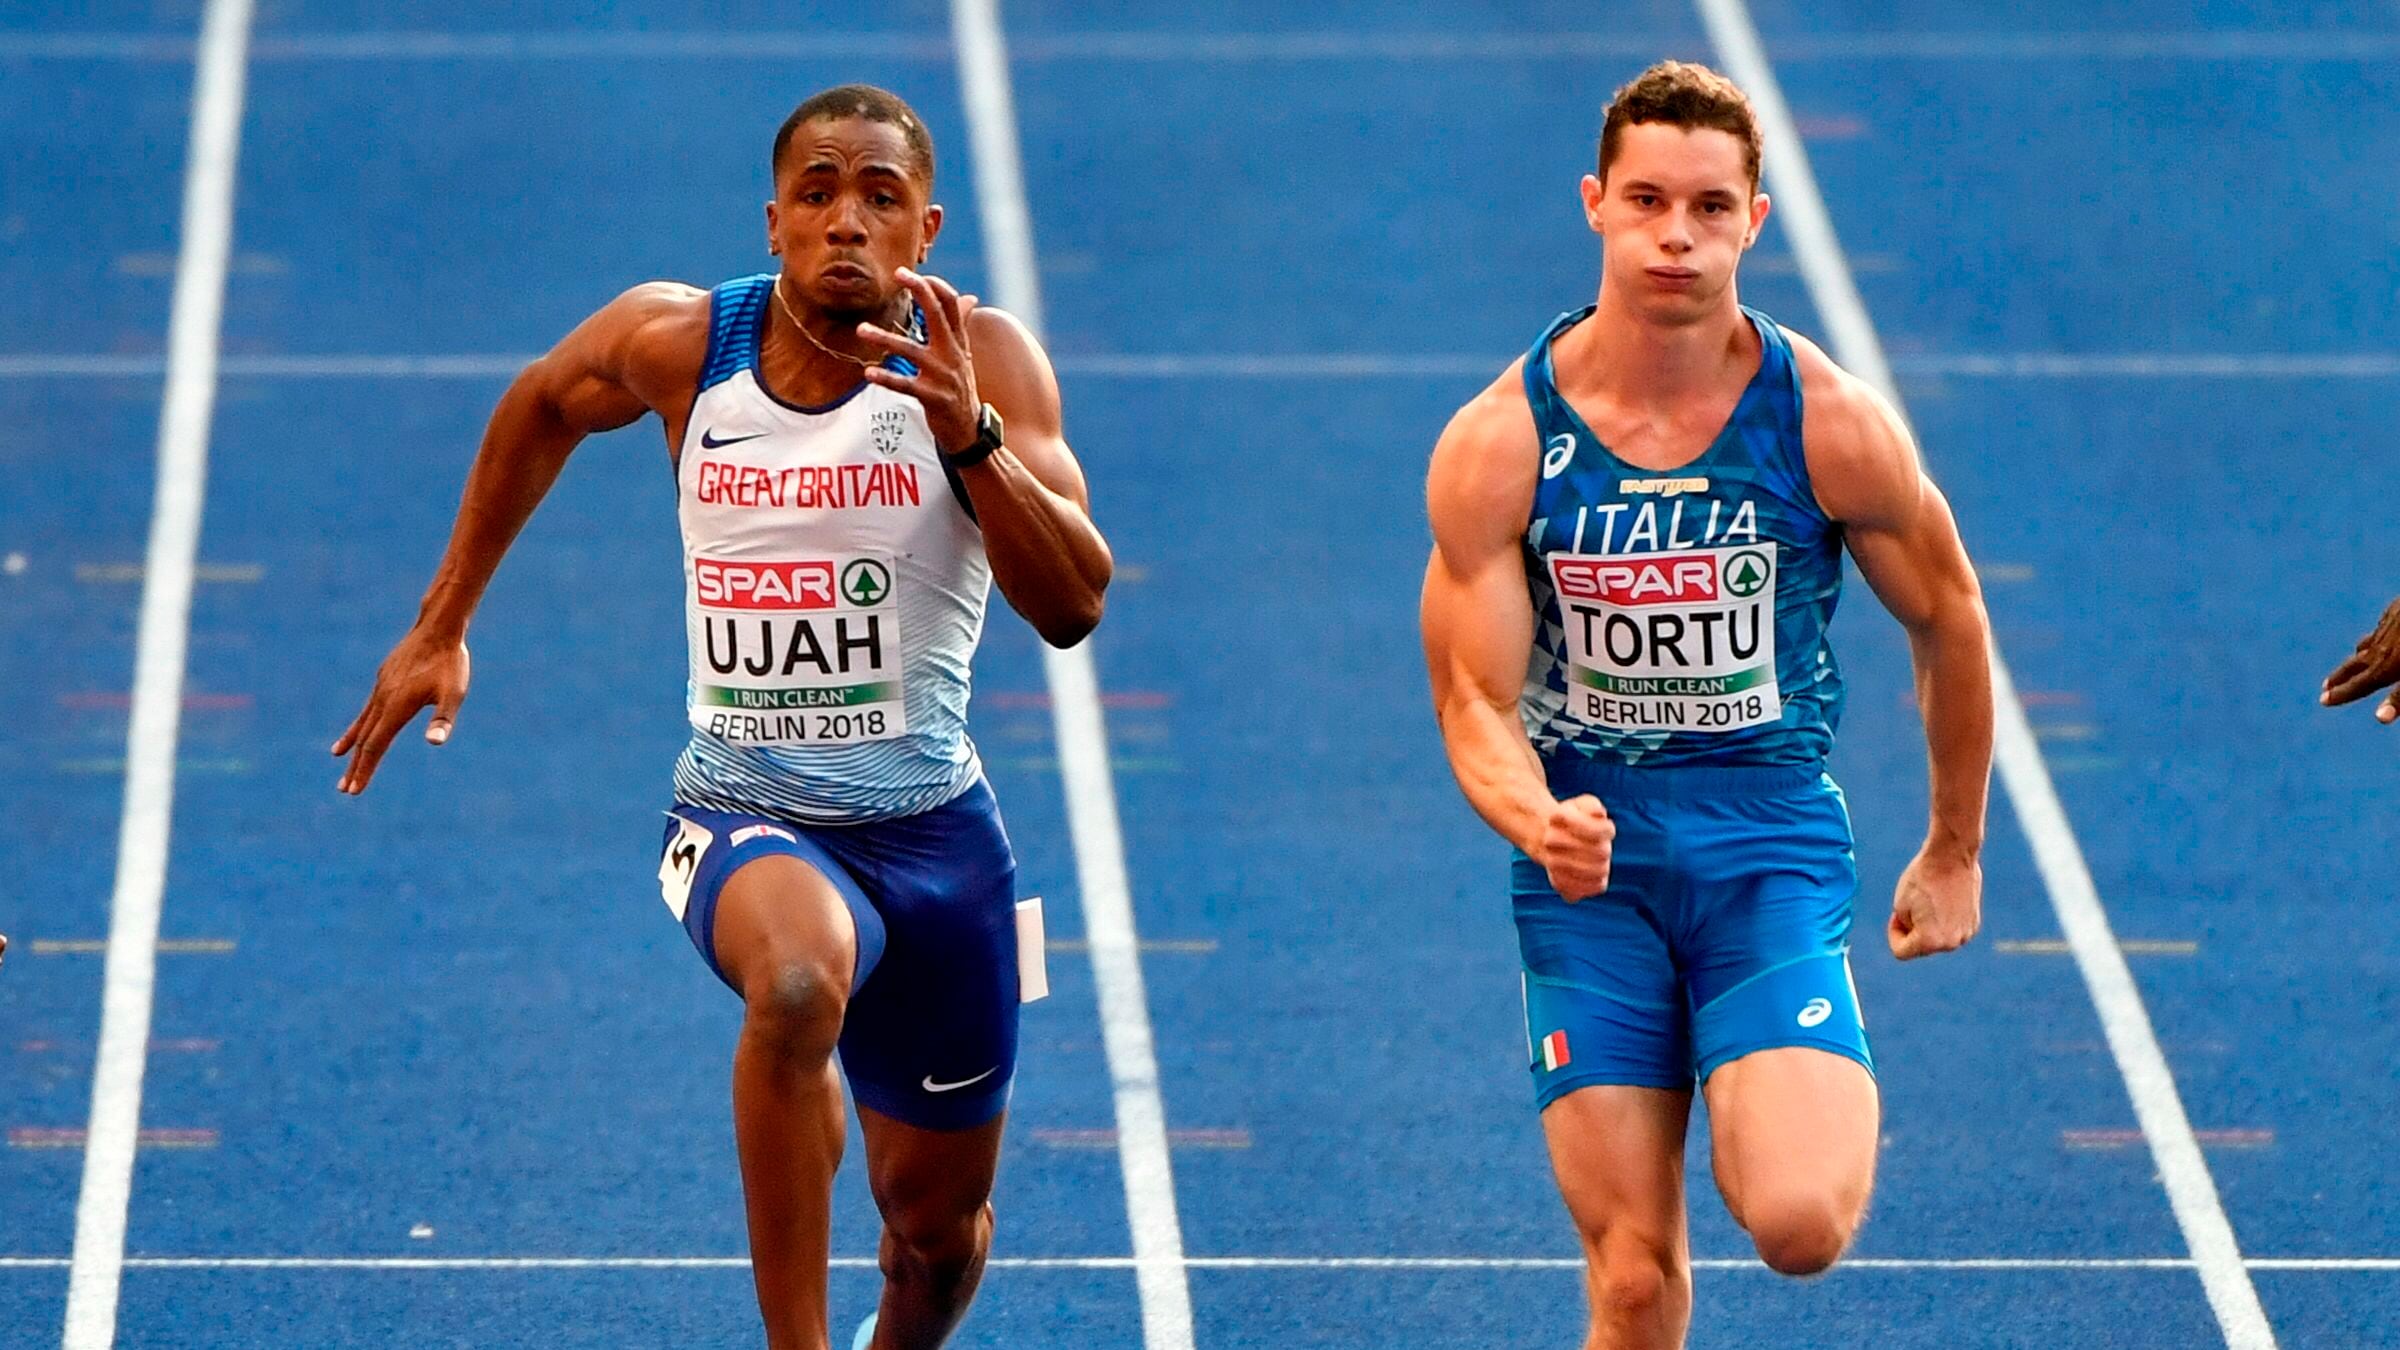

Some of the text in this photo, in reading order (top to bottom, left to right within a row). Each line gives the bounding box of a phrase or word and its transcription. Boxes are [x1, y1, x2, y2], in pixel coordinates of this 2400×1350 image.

[697, 461, 921, 508] GREAT BRITAIN
[1571, 499, 1758, 555] ITALIA
[697, 564, 831, 603] SPAR
[1559, 561, 1714, 599] SPAR
[705, 614, 882, 677] UJAH
[1570, 603, 1760, 667] TORTU
[733, 690, 739, 706] I
[742, 690, 780, 707] RUN
[1608, 677, 1614, 691] I
[1617, 678, 1658, 693] RUN
[709, 710, 886, 741] BERLIN 2018
[1586, 693, 1762, 726] BERLIN 2018
